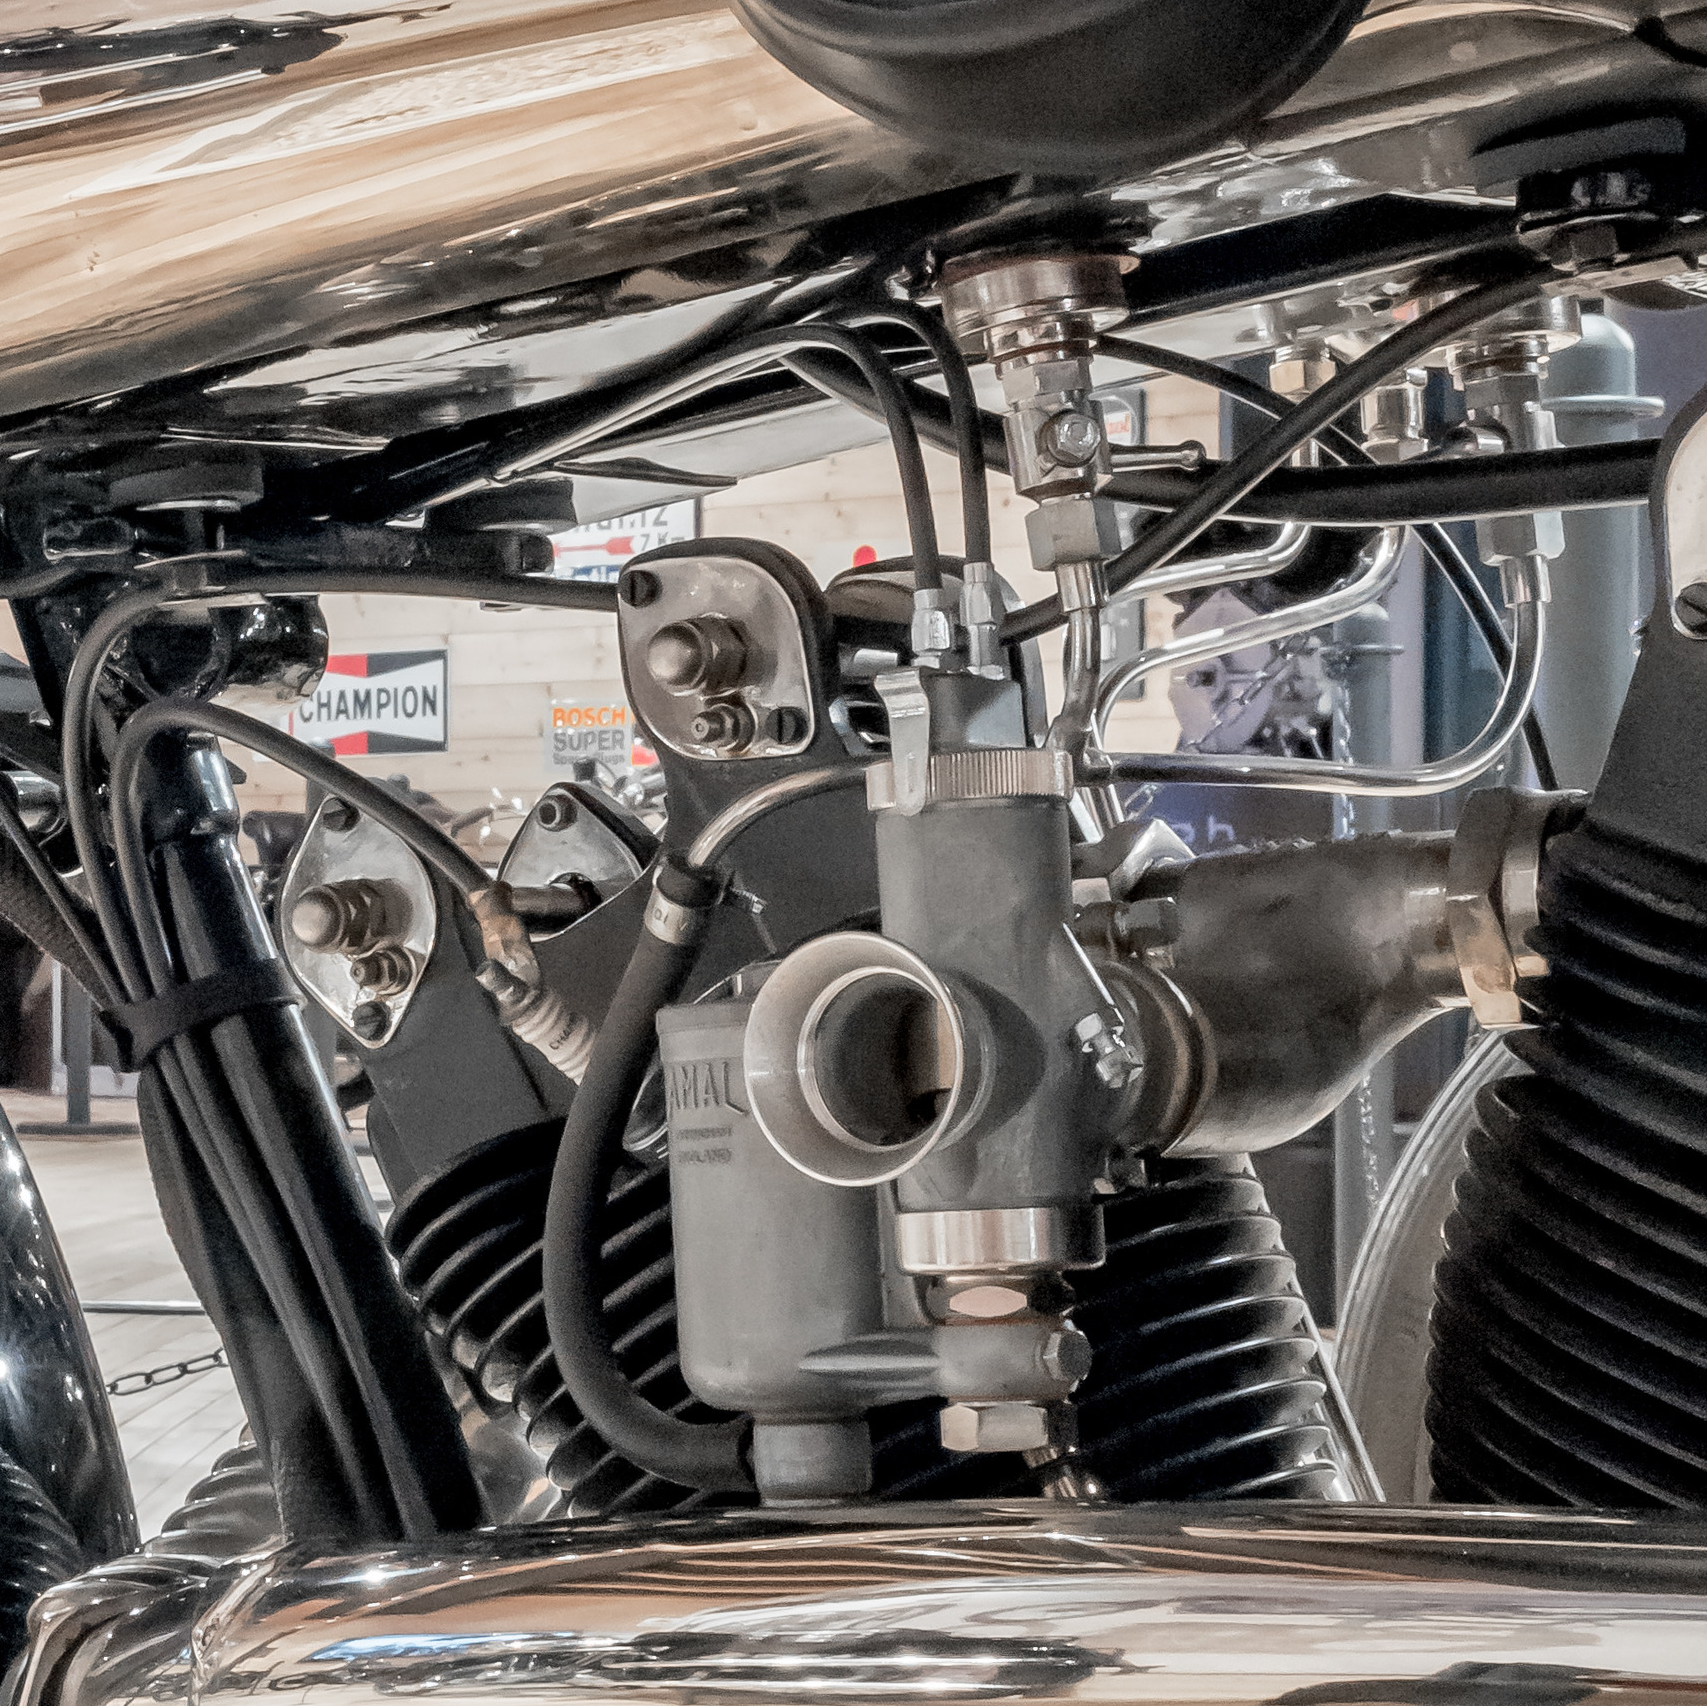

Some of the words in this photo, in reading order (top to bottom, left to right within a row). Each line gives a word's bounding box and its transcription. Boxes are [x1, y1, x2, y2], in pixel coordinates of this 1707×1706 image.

[299, 684, 438, 723] CHAMPION
[552, 706, 626, 728] BOSCH
[553, 729, 625, 752] SUPER
[667, 1060, 751, 1117] AMAL
